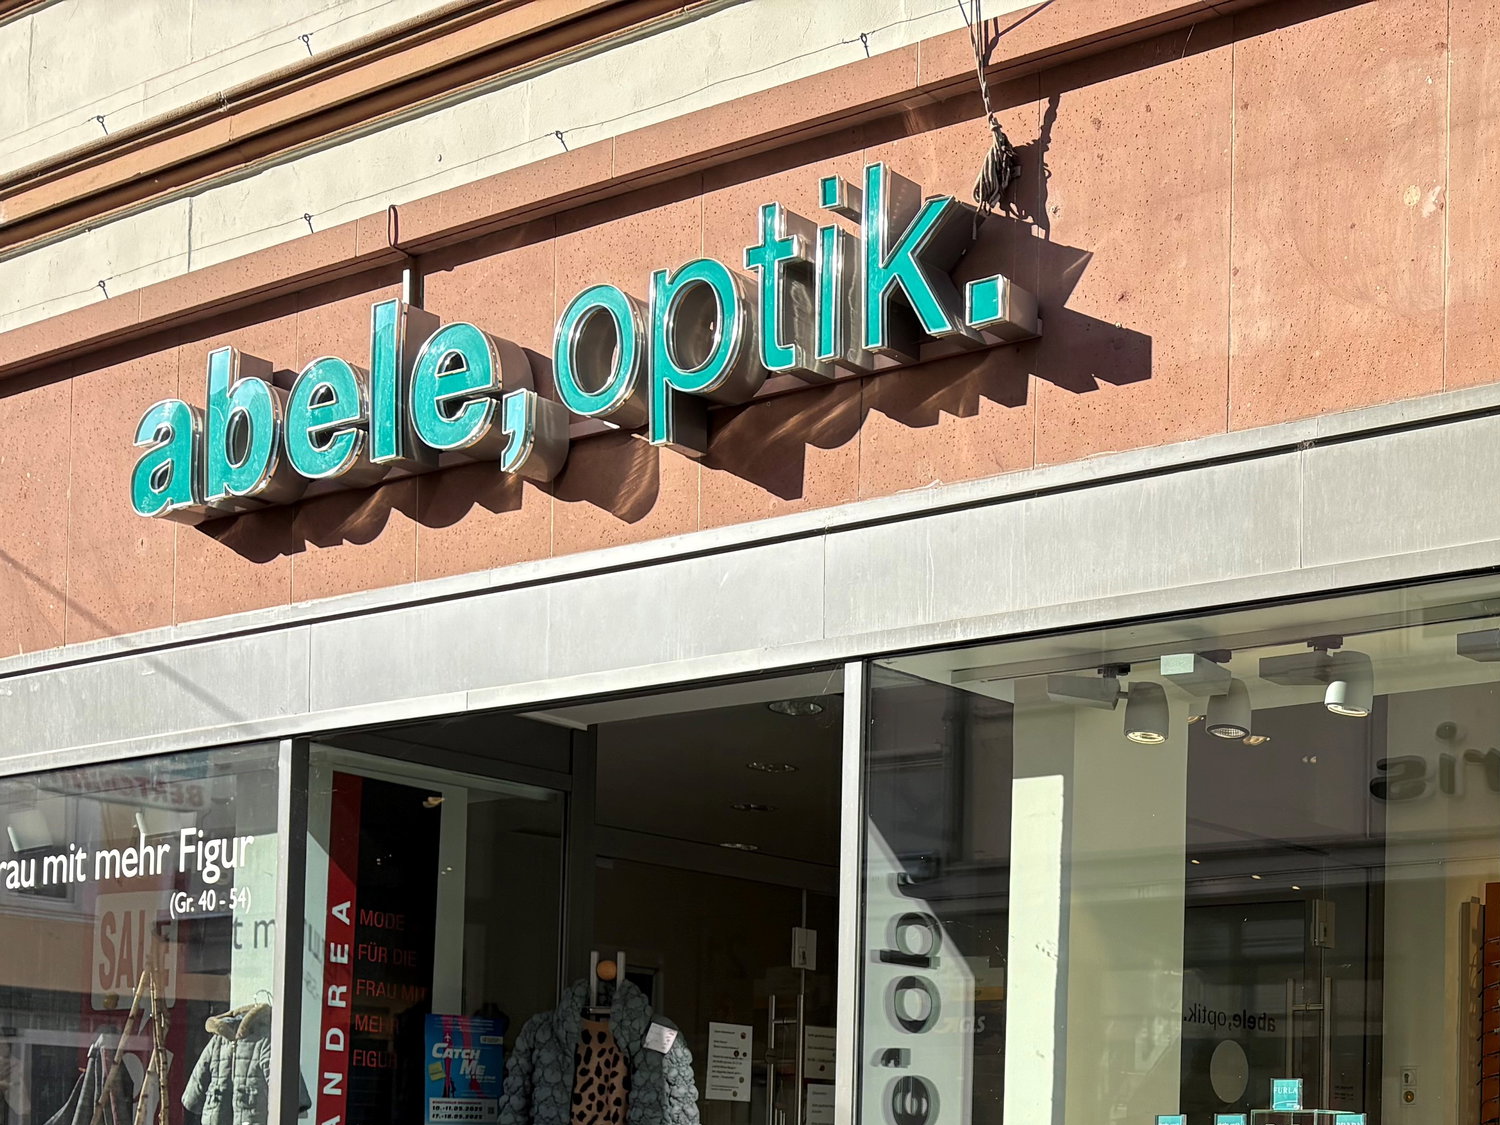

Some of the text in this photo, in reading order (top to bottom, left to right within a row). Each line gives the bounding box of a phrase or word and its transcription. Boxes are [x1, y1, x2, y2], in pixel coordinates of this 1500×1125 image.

[130, 160, 1008, 518] abele,optik.
[43, 843, 87, 885] mit
[95, 833, 171, 880] mehr
[179, 827, 255, 884] Figur
[170, 892, 195, 920] (Gr.
[198, 889, 216, 912] 40
[228, 886, 252, 914] 54)
[359, 909, 406, 931] MODE
[358, 942, 417, 967] FÜR DIE
[356, 979, 398, 1000] FRAU
[353, 1049, 399, 1069] FIGUR
[1273, 1086, 1297, 1095] FURLA
